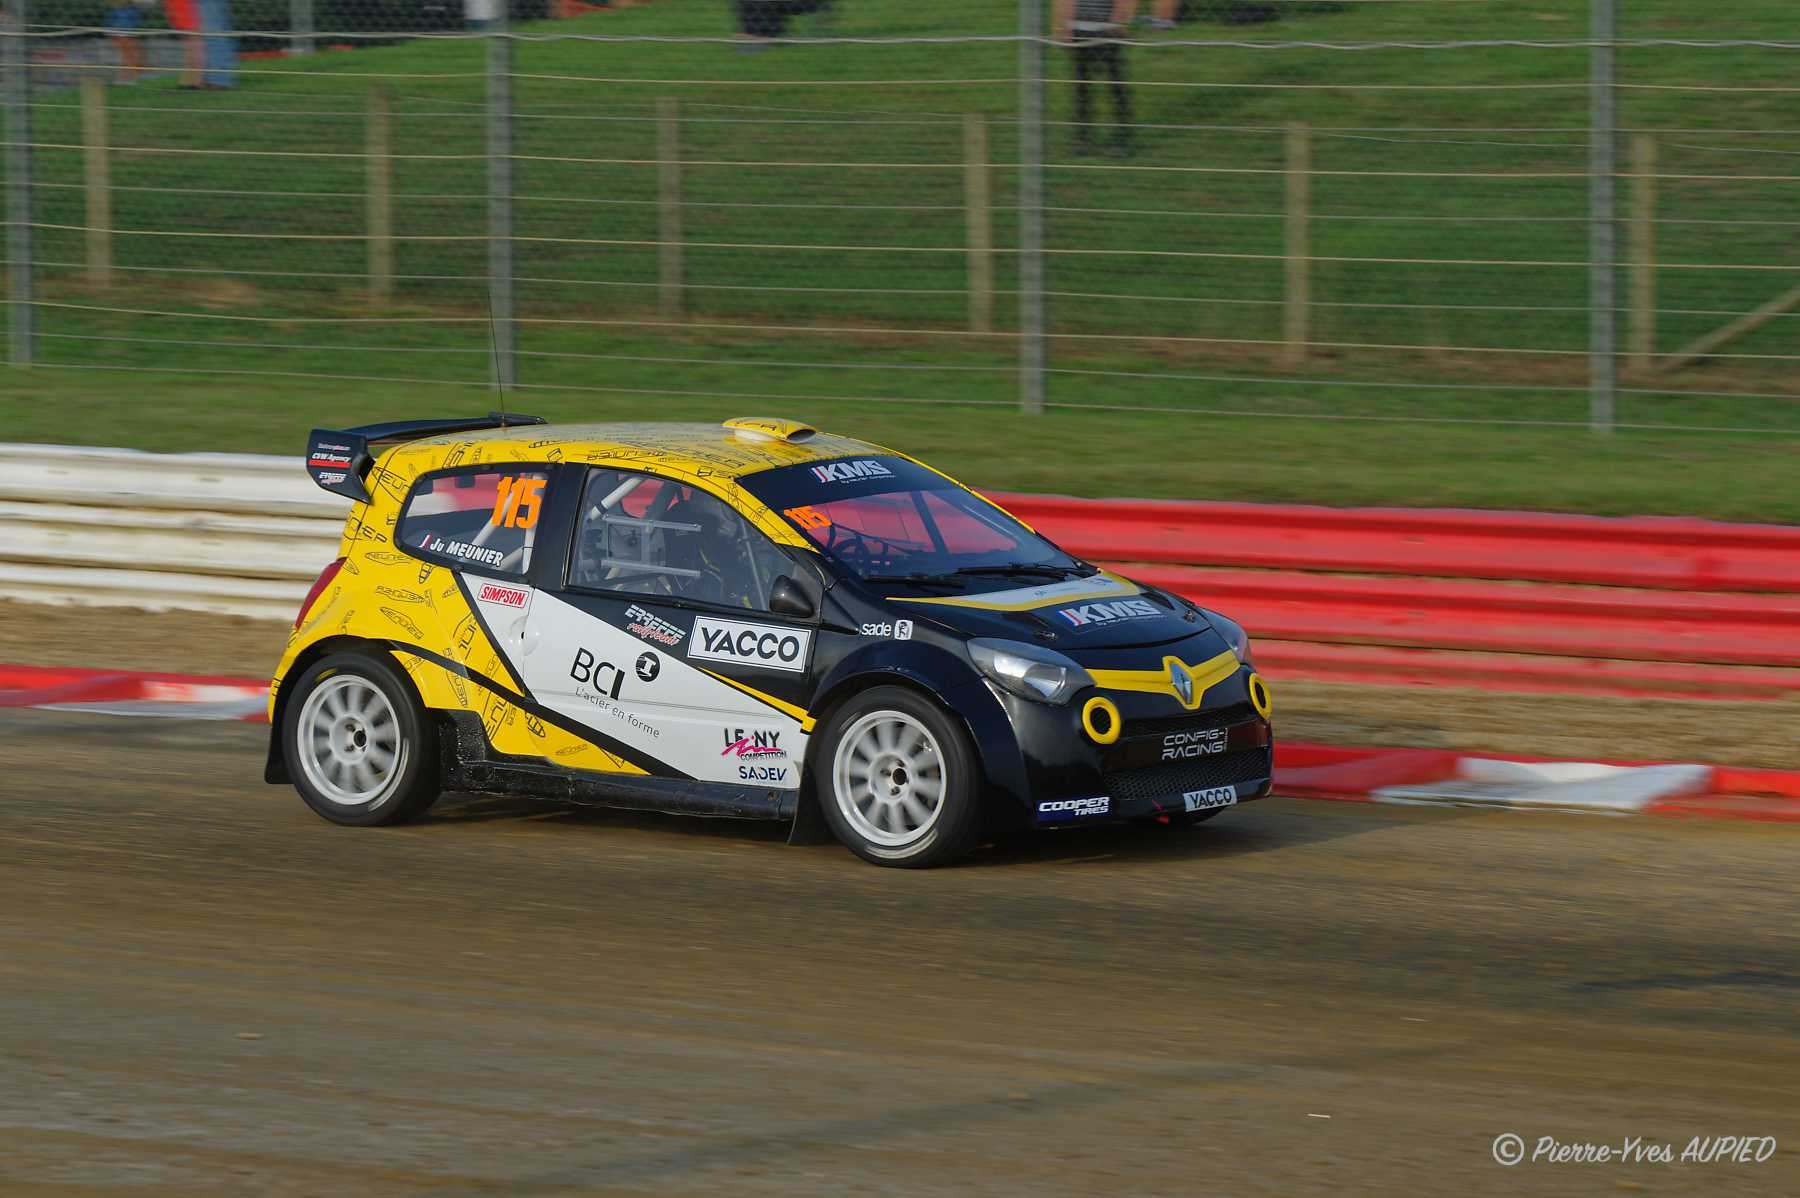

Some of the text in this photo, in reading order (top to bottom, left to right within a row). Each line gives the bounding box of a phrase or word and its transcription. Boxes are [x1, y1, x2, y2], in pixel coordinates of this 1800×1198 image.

[817, 460, 892, 483] KMS
[491, 476, 548, 529] 115
[783, 505, 833, 530] 115
[430, 538, 505, 567] Ju MEUNIER
[480, 585, 526, 606] SIMPSON
[1068, 599, 1162, 627] KMS
[861, 621, 892, 637] sade
[701, 626, 800, 663] YACCO
[570, 647, 626, 701] BCI
[575, 686, 661, 738] L'acier en forme
[724, 727, 780, 748] LE NY
[741, 750, 787, 761] COMPETITION
[1161, 740, 1225, 761] RACING
[738, 765, 788, 781] SADEV
[1038, 796, 1110, 813] COOPER
[1189, 788, 1233, 810] YACCO
[1073, 805, 1109, 817] TIRES
